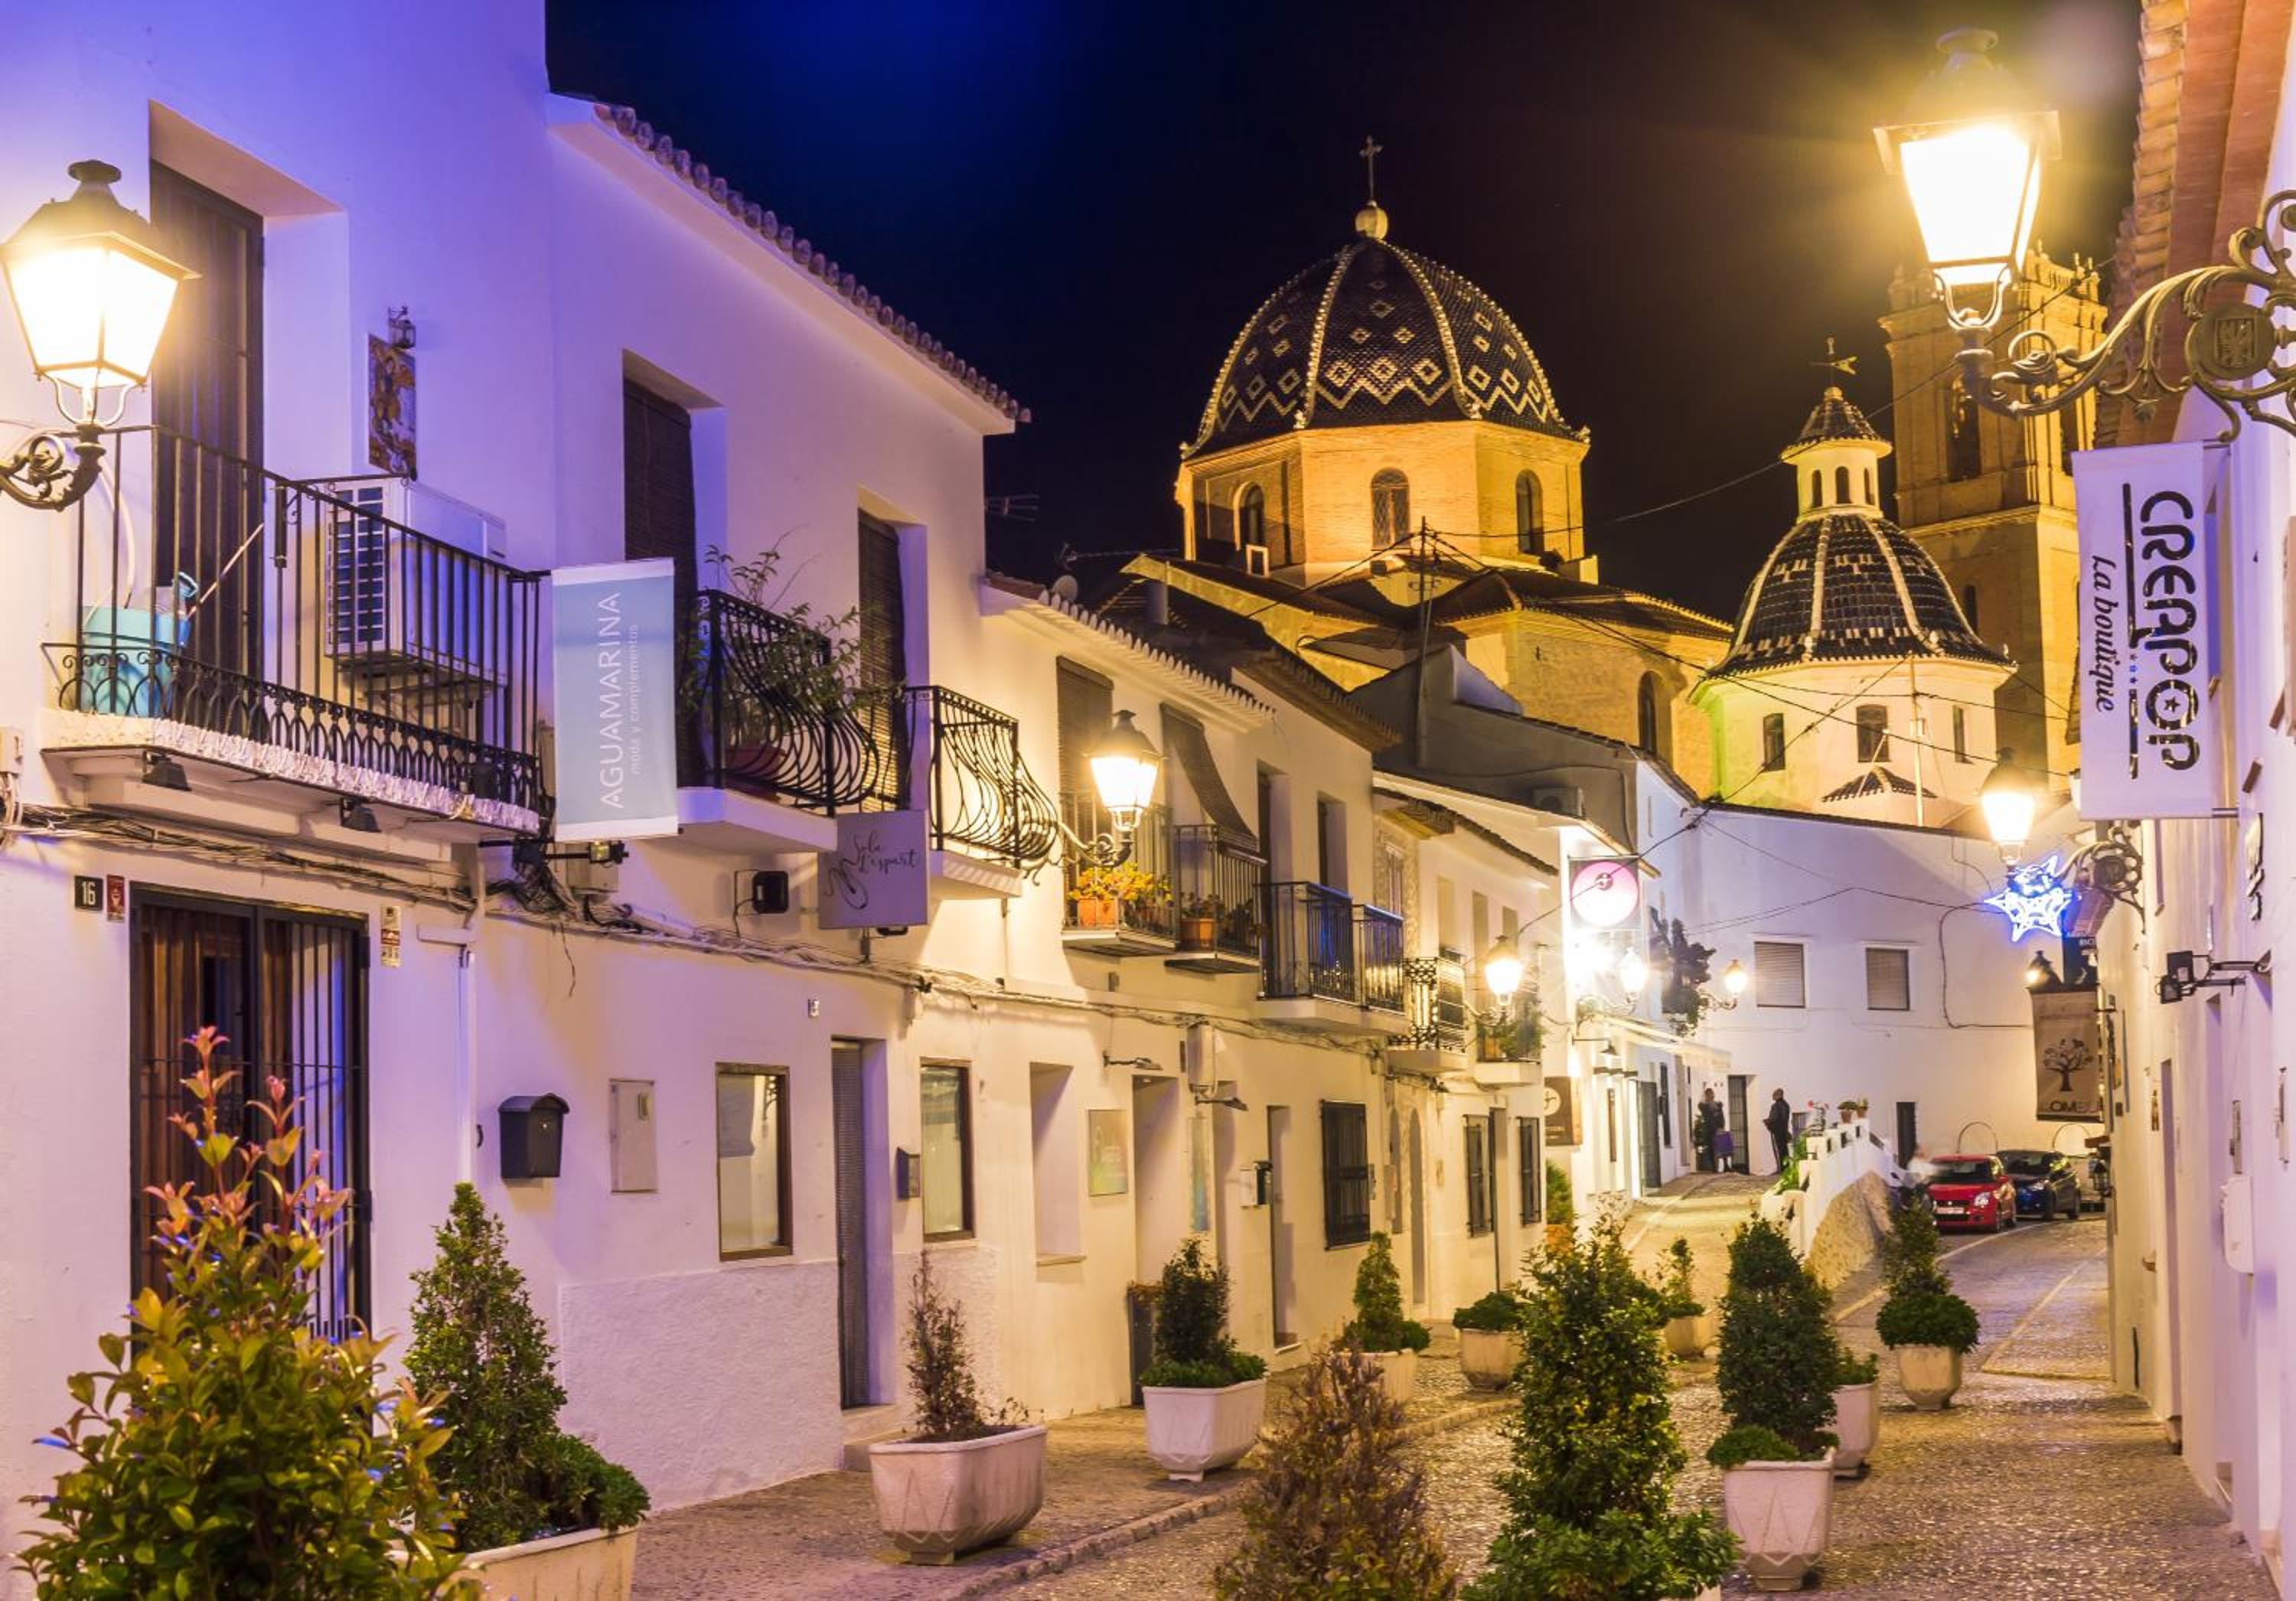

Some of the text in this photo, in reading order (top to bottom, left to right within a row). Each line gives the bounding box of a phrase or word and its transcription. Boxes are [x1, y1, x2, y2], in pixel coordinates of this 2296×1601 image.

[598, 592, 625, 809] AGUAMARINA
[2089, 555, 2119, 712] La boutique
[2139, 491, 2200, 771] CREAPOP
[81, 881, 96, 906] 16
